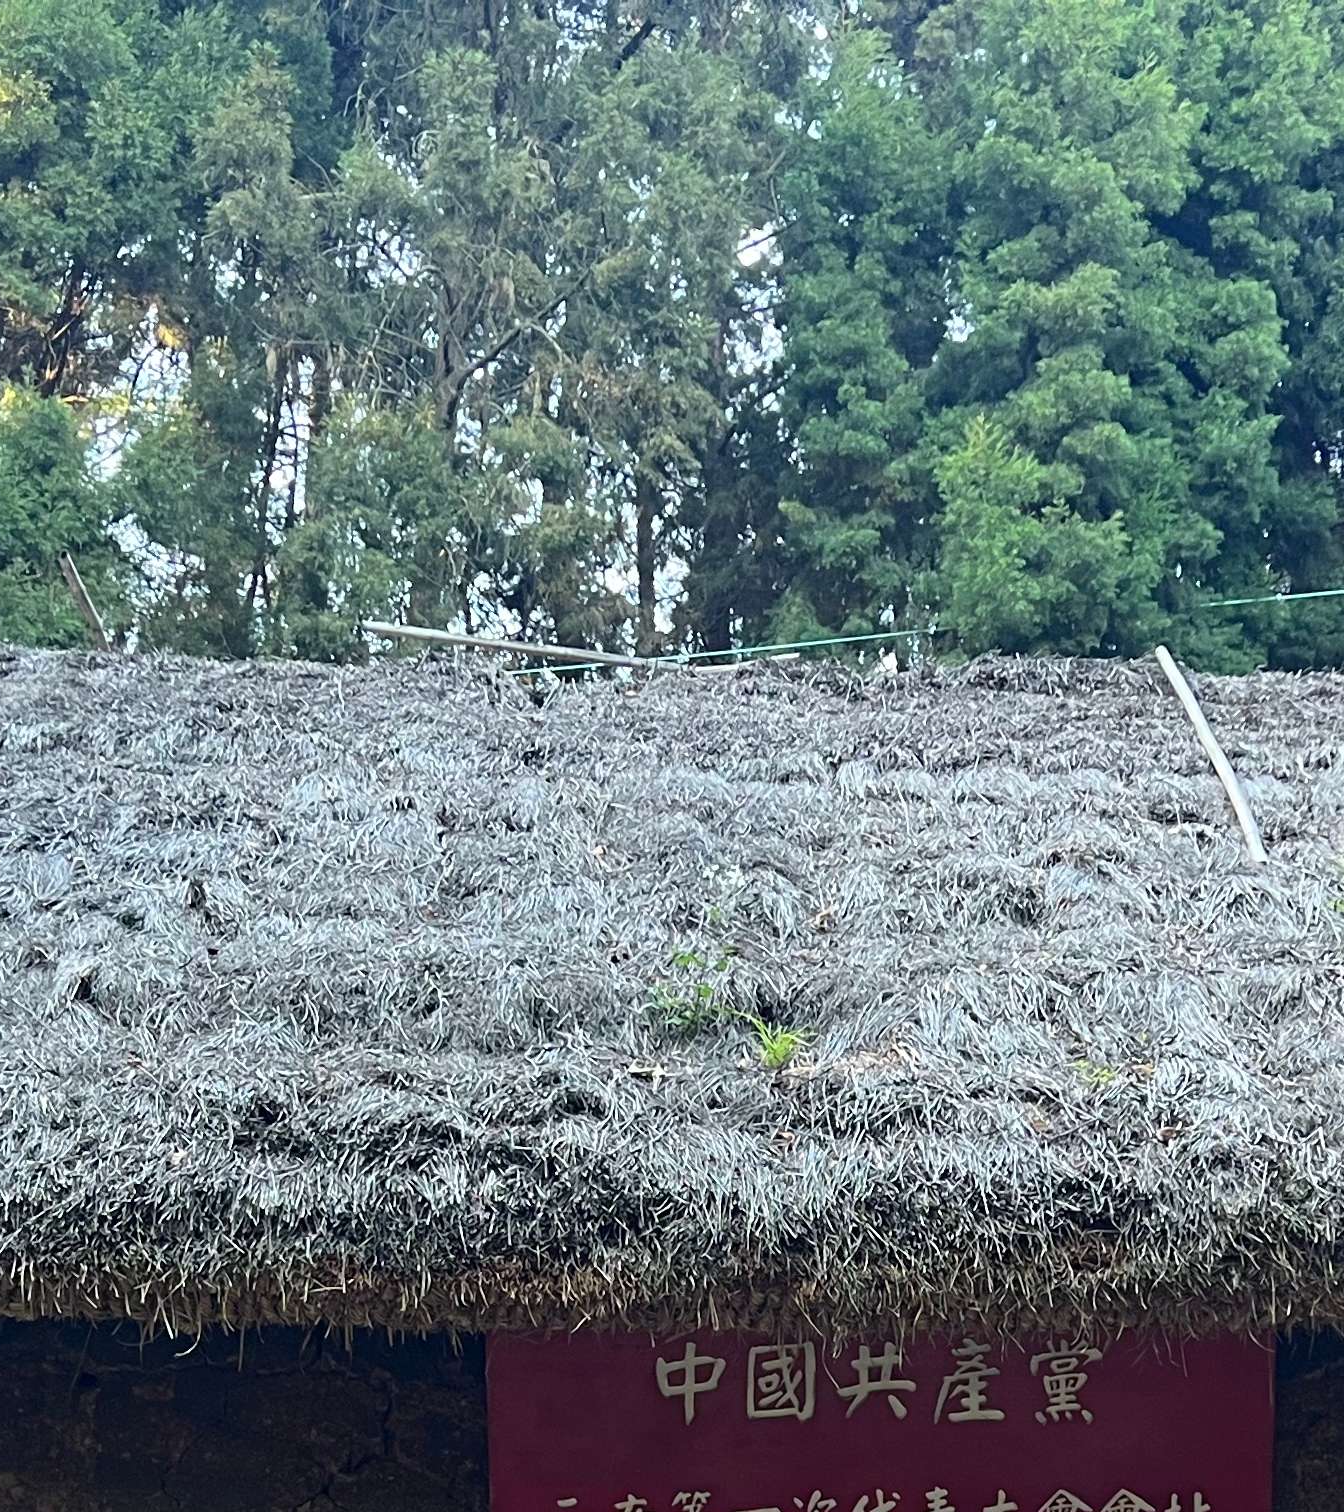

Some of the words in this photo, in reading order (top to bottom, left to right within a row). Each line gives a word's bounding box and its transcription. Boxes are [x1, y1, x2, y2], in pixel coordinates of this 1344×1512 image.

[654, 1340, 1104, 1427] 中國共產黨
